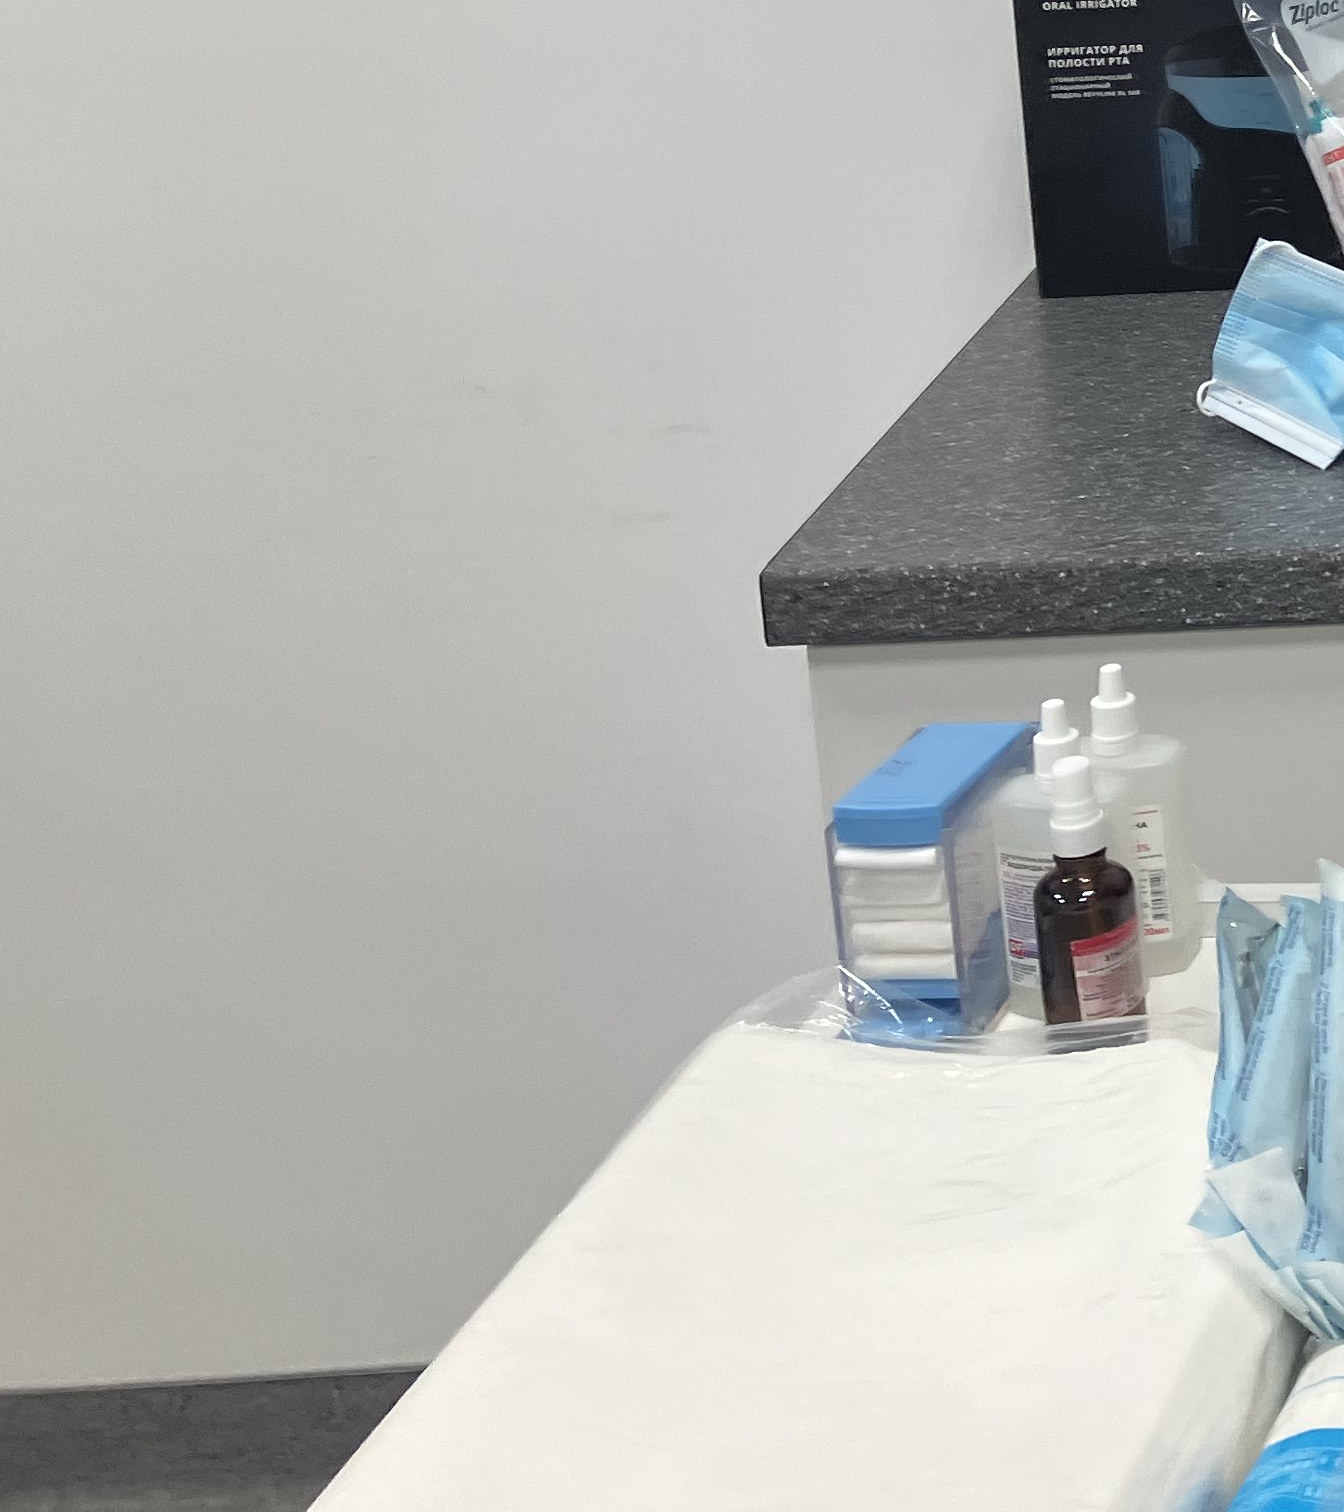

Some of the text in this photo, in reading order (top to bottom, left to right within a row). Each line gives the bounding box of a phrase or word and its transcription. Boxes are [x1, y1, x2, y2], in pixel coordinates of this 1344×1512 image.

[1042, 0, 1074, 11] ORAL
[1047, 44, 1144, 57] ИРРИГАТОР ДЛЯ
[1048, 56, 1131, 68] ПОЛОСТИ РТА
